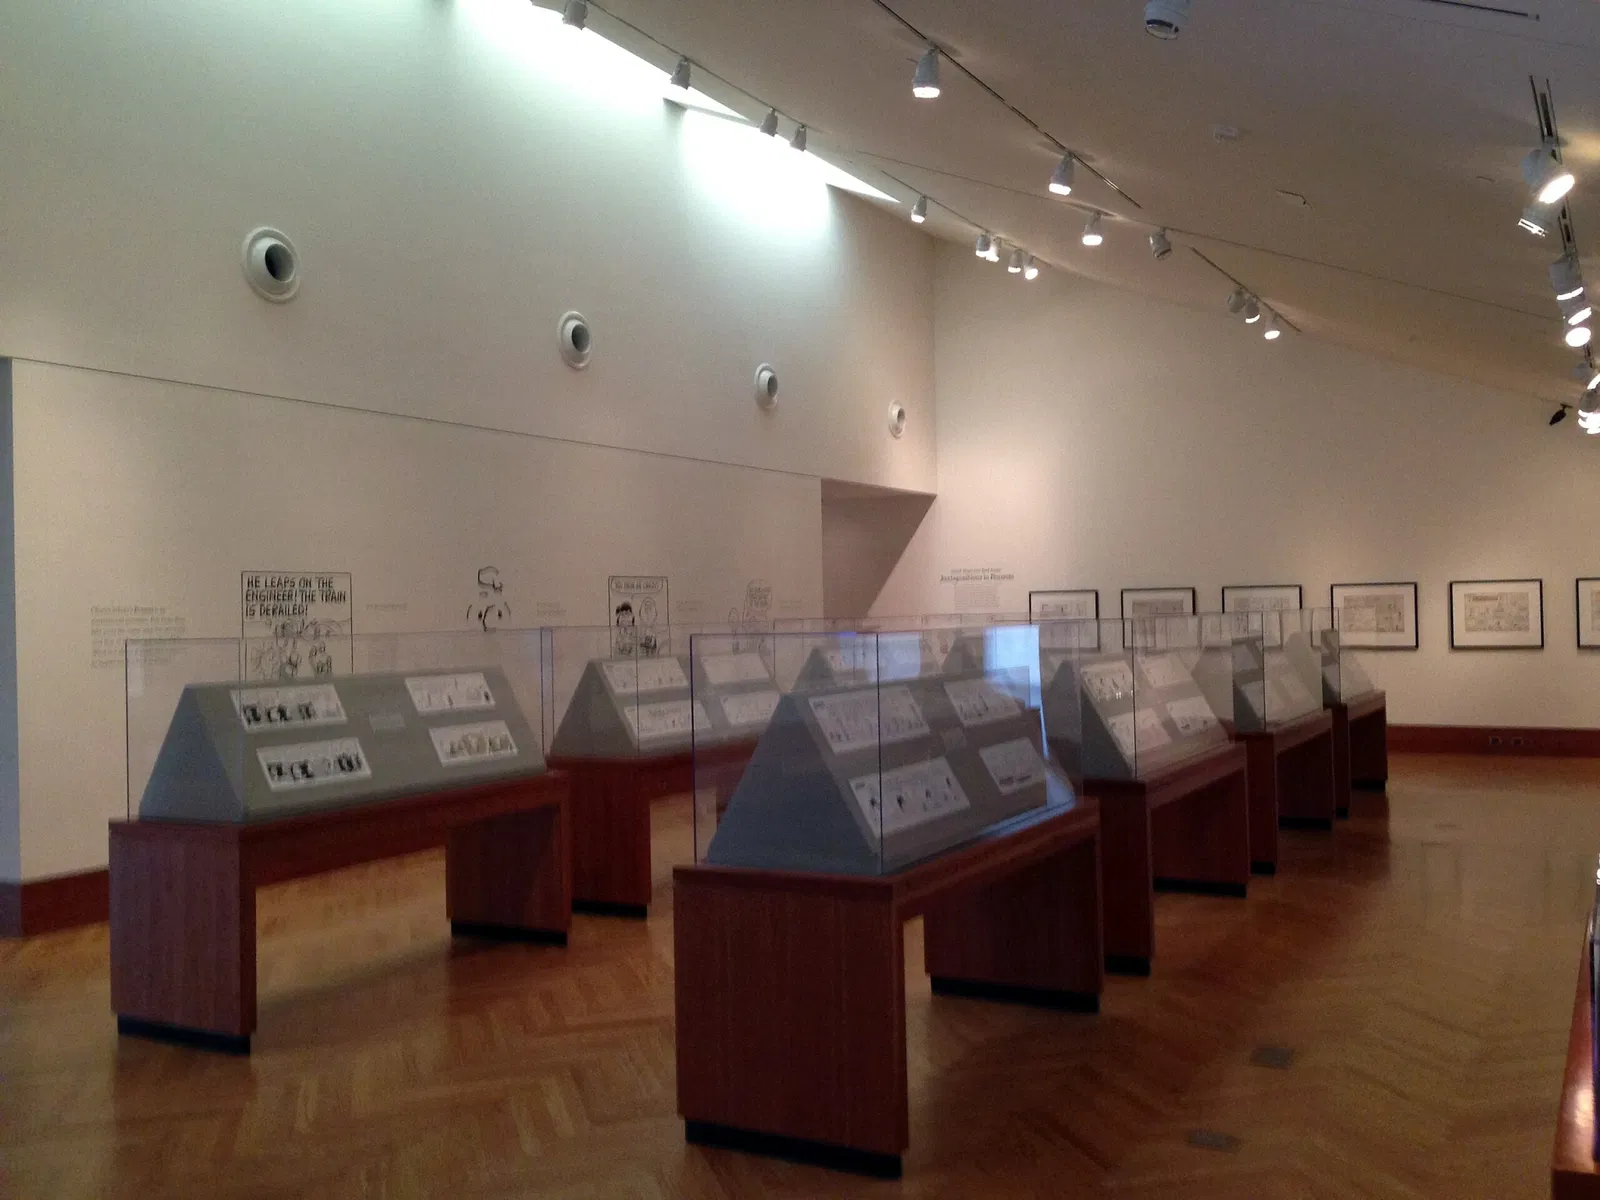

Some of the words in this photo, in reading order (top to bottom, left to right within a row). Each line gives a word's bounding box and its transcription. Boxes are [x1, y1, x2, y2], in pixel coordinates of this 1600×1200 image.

[247, 576, 260, 588] HE
[265, 576, 296, 588] LEAPS
[299, 577, 312, 588] ON
[316, 577, 334, 588] THE
[245, 589, 297, 602] ENGINEER!
[299, 590, 316, 602] THE
[319, 590, 346, 602] TRAIN
[246, 604, 256, 616] IS
[260, 604, 308, 616] DERAILED!
